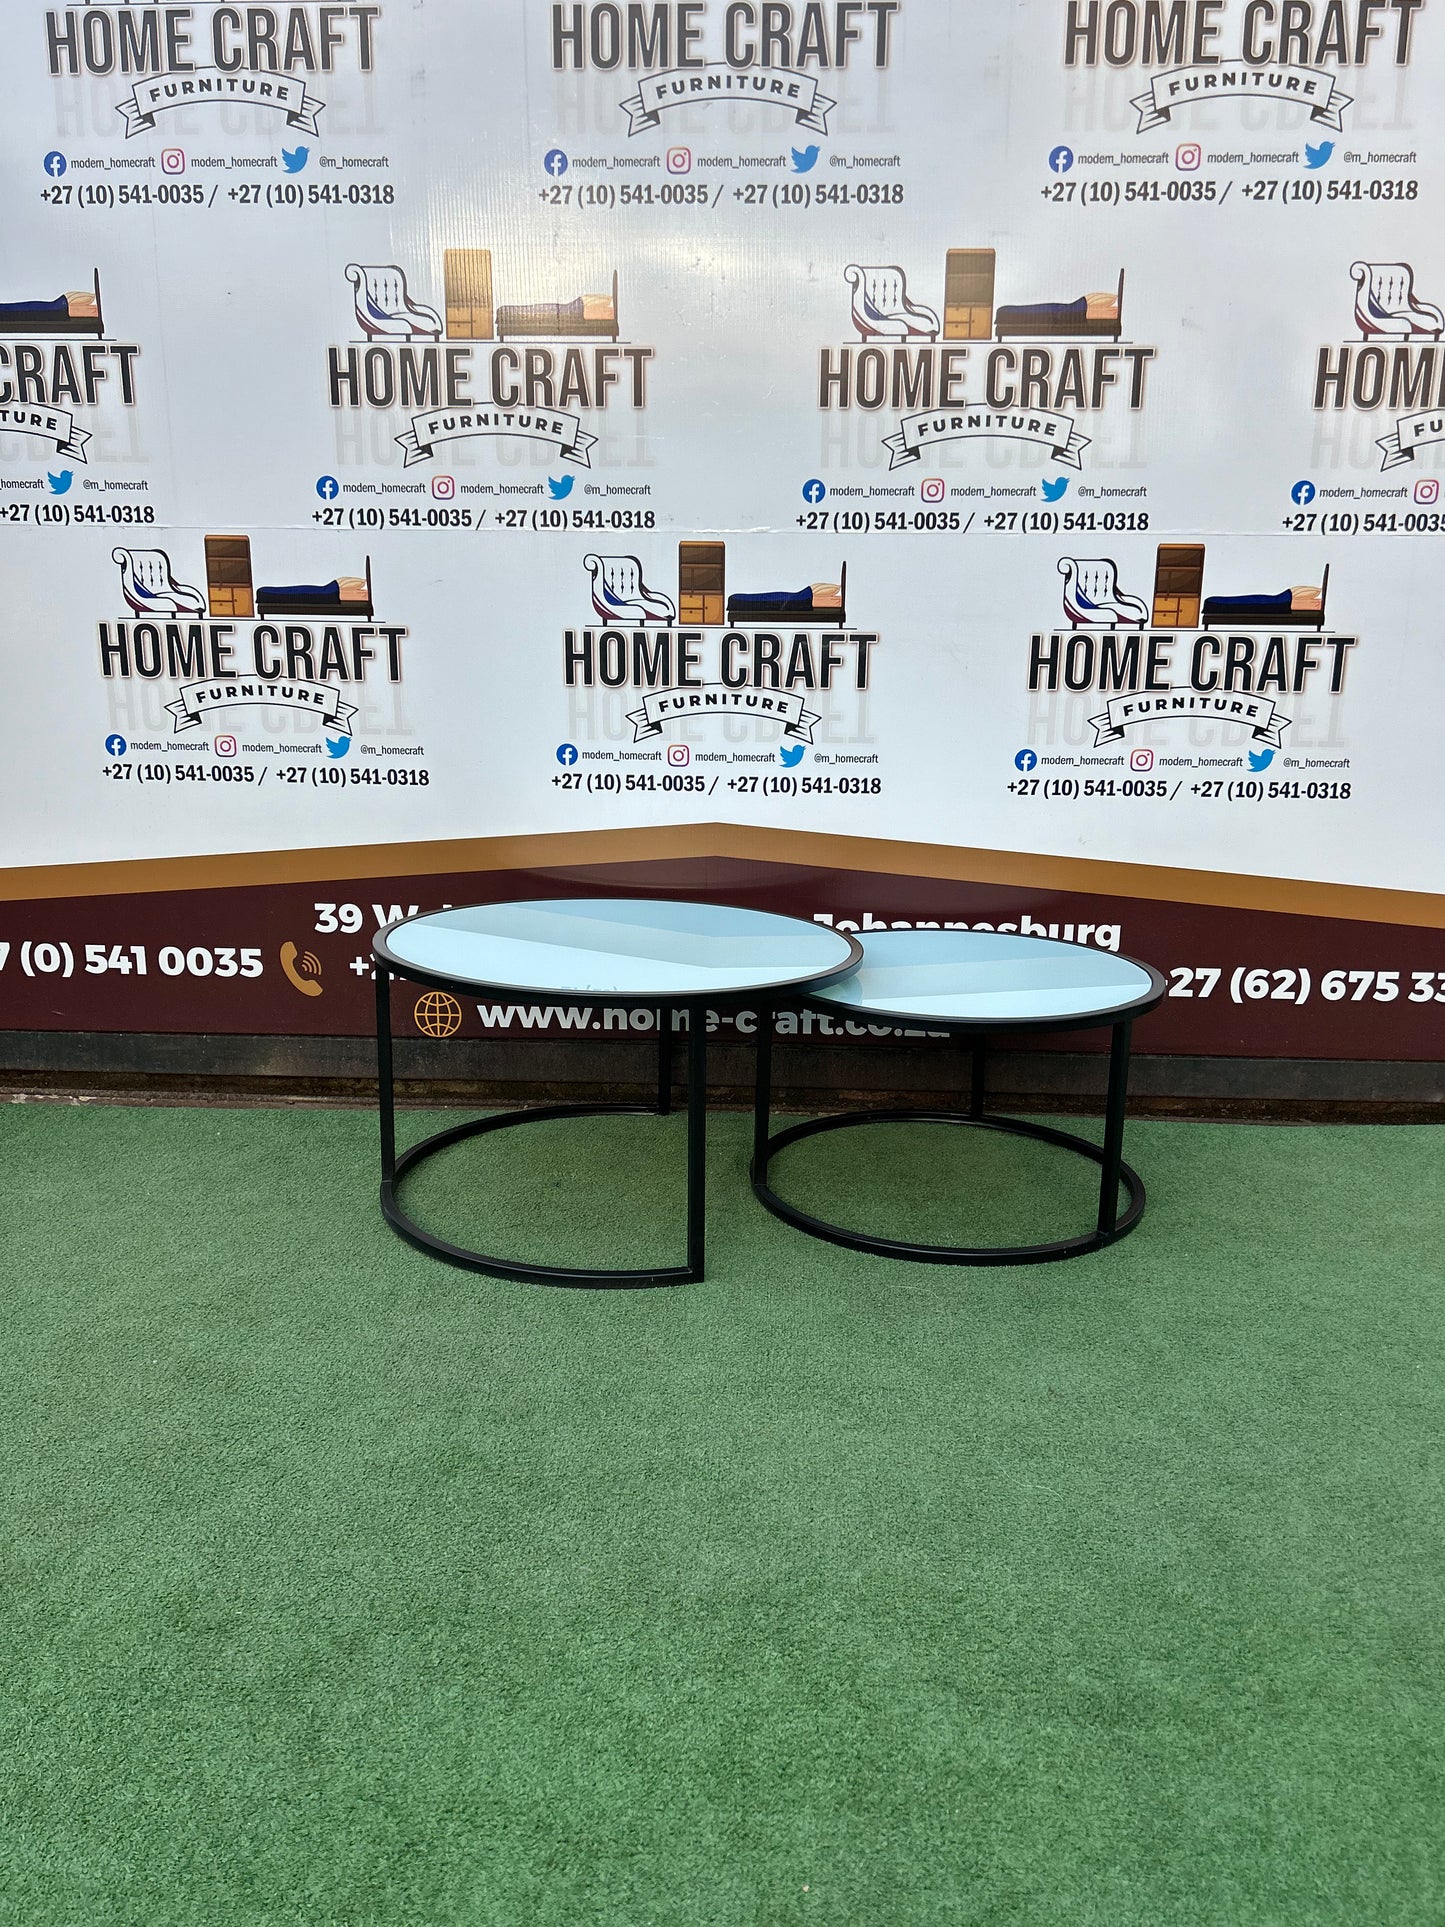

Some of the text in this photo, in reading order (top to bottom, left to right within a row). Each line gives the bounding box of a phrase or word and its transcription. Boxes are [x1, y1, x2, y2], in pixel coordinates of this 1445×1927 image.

[46, 8, 379, 75] HOME CRAFT
[553, 2, 897, 70] HOME CRAFT
[1065, 0, 1424, 66] HOME CRAFT
[149, 79, 289, 102] FURNITURE
[655, 75, 800, 100] FURNITURE
[1169, 73, 1317, 96] FURNITURE
[71, 155, 389, 170] modern_homecraft modern_homecraft @m_homecraft
[572, 155, 901, 168] modern_homecraft modern_homecraft @m_homecraft
[1078, 151, 1416, 166] modern_homecraft modern_homecraft @m_homecraft
[41, 186, 73, 205] +27
[77, 185, 114, 209] (10)
[119, 186, 204, 205] 541-0035
[228, 185, 261, 204] +27
[266, 185, 304, 208] (10)
[308, 185, 394, 205] 541-0318
[539, 185, 573, 205] +27
[578, 185, 615, 209] (10)
[620, 185, 708, 205] 541-0035
[733, 185, 767, 204] +27
[773, 185, 811, 209] (10)
[815, 185, 904, 205] 541-0318
[1041, 182, 1076, 202] +27
[1081, 181, 1120, 206] (10)
[1125, 181, 1216, 201] 541-0035
[1242, 180, 1278, 200] +27
[1282, 180, 1322, 205] (10)
[1327, 180, 1418, 201] 541-0318
[328, 348, 652, 408] HOME CRAFT
[819, 349, 1153, 409] HOME CRAFT
[1314, 347, 1445, 408] HOM
[428, 414, 564, 435] FURNITURE
[918, 415, 1057, 437] FURNITURE
[83, 480, 148, 491] @m_homecraft
[343, 482, 651, 497] modern_homecraft modern_homecraft @m_homecraft
[830, 484, 1147, 498] modern_homecraft modern_homecraft @m_homecraft
[1319, 488, 1407, 499] modern_homecraft
[35, 504, 70, 525] (10)
[74, 505, 155, 523] 541-0318
[312, 509, 344, 526] +27
[349, 508, 384, 529] (10)
[389, 509, 472, 527] 541-0035
[495, 511, 527, 527] +27
[532, 510, 567, 531] (10)
[572, 511, 655, 529] 541-0318
[796, 513, 829, 531] +27
[833, 512, 869, 534] (10)
[874, 513, 959, 530] 541-0035
[984, 513, 1018, 530] +27
[1022, 513, 1059, 534] (10)
[1063, 513, 1149, 531] 541-0318
[1283, 514, 1317, 531] +27
[1321, 514, 1359, 535] (10)
[99, 624, 406, 682] HOME CRAFT
[564, 631, 878, 689] HOME CRAFT
[1028, 636, 1356, 692] HOME CRAFT
[196, 685, 324, 705] FURNITURE
[658, 694, 788, 713] FURNITURE
[1123, 698, 1259, 717] FURNITURE
[130, 739, 424, 756] modern_homecraft modern_homecraft @m_homecraft
[582, 749, 878, 764] modern_homecraft modern_homecraft @m_homecraft
[1041, 754, 1350, 769] modern_homecraft modern_homecraft @m_homecraft
[102, 764, 132, 781] +27
[137, 764, 171, 784] (10)
[175, 765, 254, 782] 541-0035
[276, 768, 307, 784] +27
[312, 768, 346, 788] (10)
[350, 769, 429, 786] 541-0318
[552, 774, 582, 789] +27
[587, 773, 621, 794] (10)
[625, 774, 705, 791] 541-0035
[728, 777, 759, 792] +27
[763, 776, 797, 797] (10)
[801, 778, 881, 794] 541-0318
[1008, 780, 1040, 796] +27
[1044, 780, 1079, 799] (10)
[1084, 781, 1167, 797] 541-0035
[1191, 782, 1223, 798] +27
[1228, 782, 1263, 801] (10)
[1268, 782, 1351, 799] 541-0318
[314, 903, 363, 933] 39
[814, 913, 1121, 951] Jhsburg
[21, 941, 74, 978] (0)
[85, 944, 147, 975] 541
[159, 946, 263, 978] 0035
[1165, 968, 1221, 999] 27
[1230, 967, 1311, 1005] (62)
[1320, 971, 1400, 1003] 675
